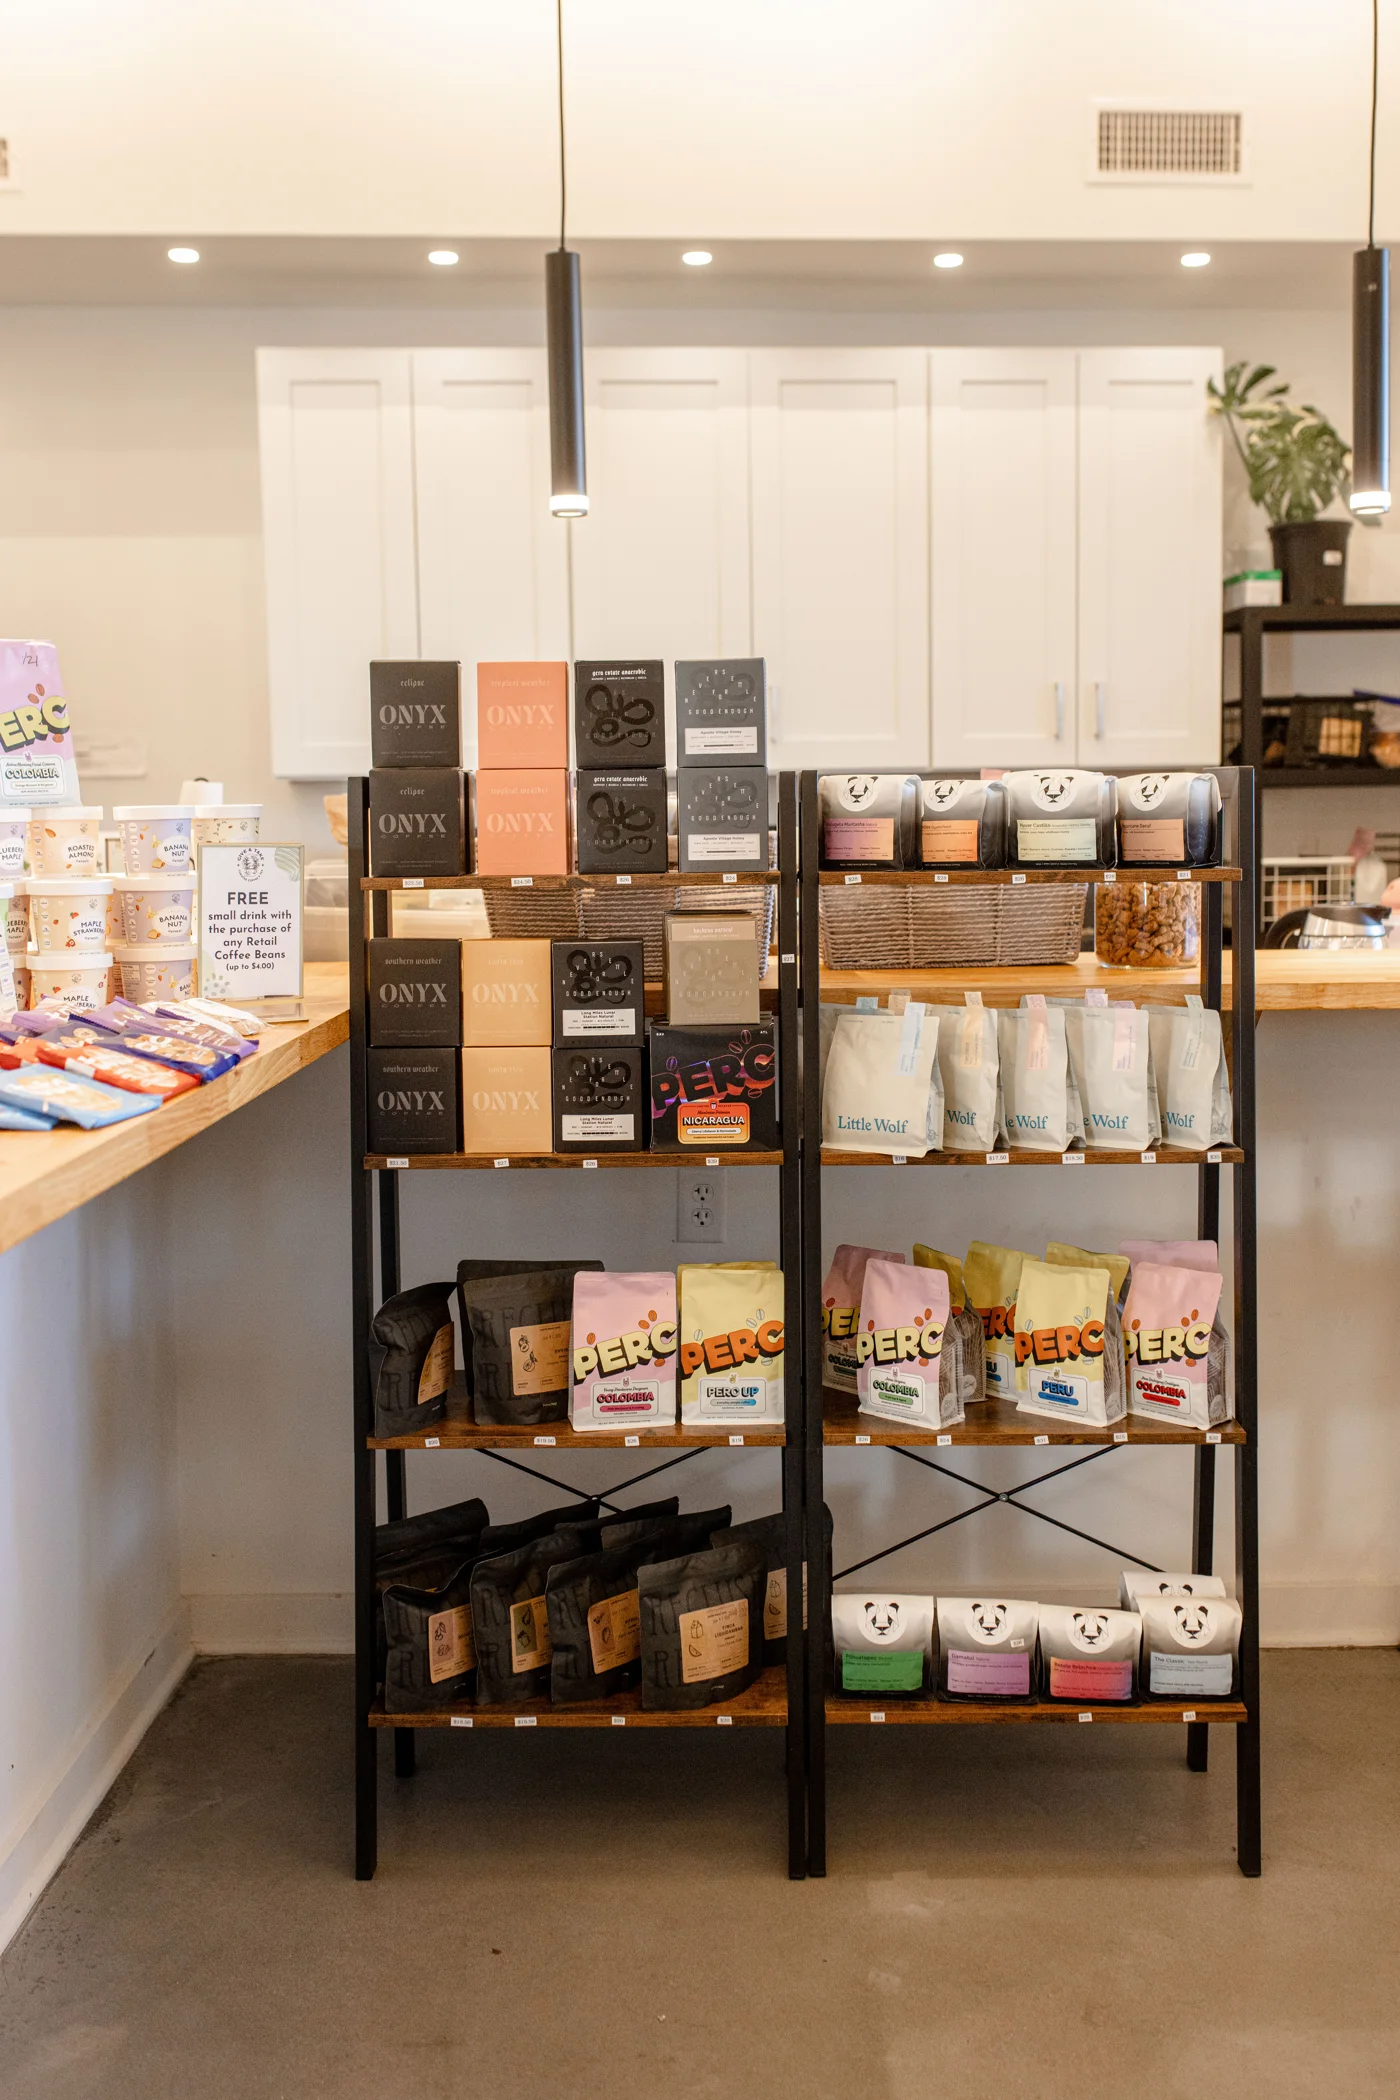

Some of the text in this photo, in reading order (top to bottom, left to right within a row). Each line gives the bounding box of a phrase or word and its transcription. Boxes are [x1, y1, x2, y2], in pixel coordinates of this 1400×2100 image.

[400, 678, 425, 687] eclipse
[379, 704, 447, 724] ONYX
[486, 704, 555, 724] ONYX
[0, 695, 70, 753] ERC
[5, 767, 60, 779] COLOMBIA
[400, 787, 425, 796] eclipse
[378, 813, 447, 833] ONYX
[486, 813, 554, 833] ONYX
[67, 844, 95, 853] ROASTED
[68, 851, 95, 859] ALMOND
[237, 848, 247, 862] GIVE
[254, 848, 264, 861] TAKE
[1, 853, 22, 861] MAPLE
[227, 891, 269, 905] FREE
[208, 909, 292, 920] small drink with
[80, 920, 102, 928] MAPLE
[167, 920, 183, 928] NUT
[208, 923, 291, 935] the purchase of
[223, 936, 277, 948] any Retail
[214, 949, 286, 960] Coffee Beans
[384, 957, 442, 965] southern weather
[226, 962, 275, 971] (up to $4.00)
[379, 983, 448, 1003] ONYX
[472, 983, 539, 1003] ONYX
[382, 1065, 439, 1073] southern weather
[651, 1043, 775, 1119] PERC
[377, 1090, 445, 1110] ONYX
[472, 1090, 540, 1110] ONYX
[682, 1116, 745, 1126] NICARAGUA
[837, 1115, 909, 1134] Little Wolf
[946, 1109, 977, 1126] Wolf
[1015, 1115, 1049, 1129] Wolf
[1091, 1113, 1129, 1129] Wolf
[1166, 1111, 1195, 1128] Wolf
[681, 1320, 785, 1381] PERC
[856, 1321, 945, 1369] PERC
[1015, 1320, 1105, 1368] PERC
[1122, 1321, 1212, 1366] PERC
[573, 1321, 678, 1386] PERC
[706, 1386, 759, 1398] PERC UP
[872, 1379, 920, 1399] COLOMBIA
[1041, 1379, 1075, 1397] PERU
[1136, 1379, 1187, 1399] COLOMBIA
[596, 1391, 654, 1404] COLOMBIA
